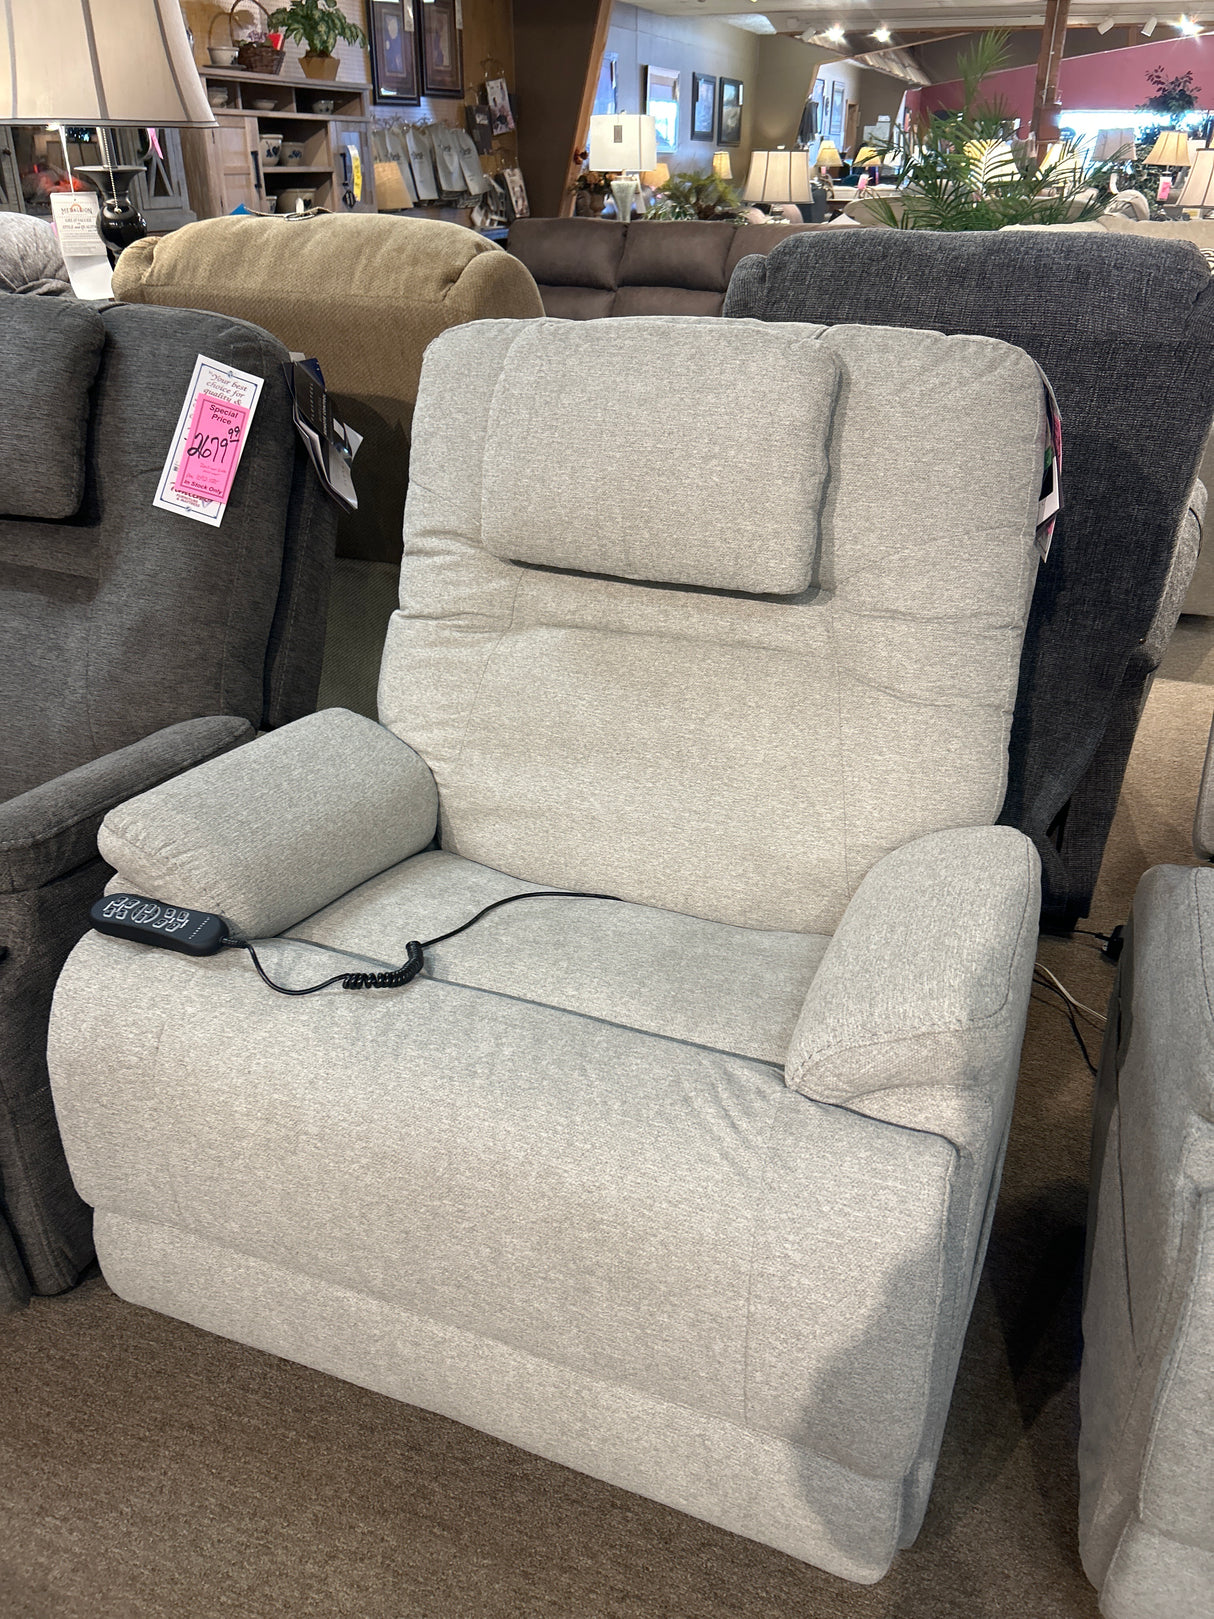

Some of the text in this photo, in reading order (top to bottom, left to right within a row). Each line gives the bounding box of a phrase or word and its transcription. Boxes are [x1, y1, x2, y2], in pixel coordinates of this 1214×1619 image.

[206, 381, 246, 399] choice for
[231, 381, 248, 392] best
[203, 388, 232, 403] quality
[209, 404, 239, 419] Special
[211, 414, 232, 425] Price
[191, 481, 207, 490] Stock
[208, 486, 222, 495] Only
